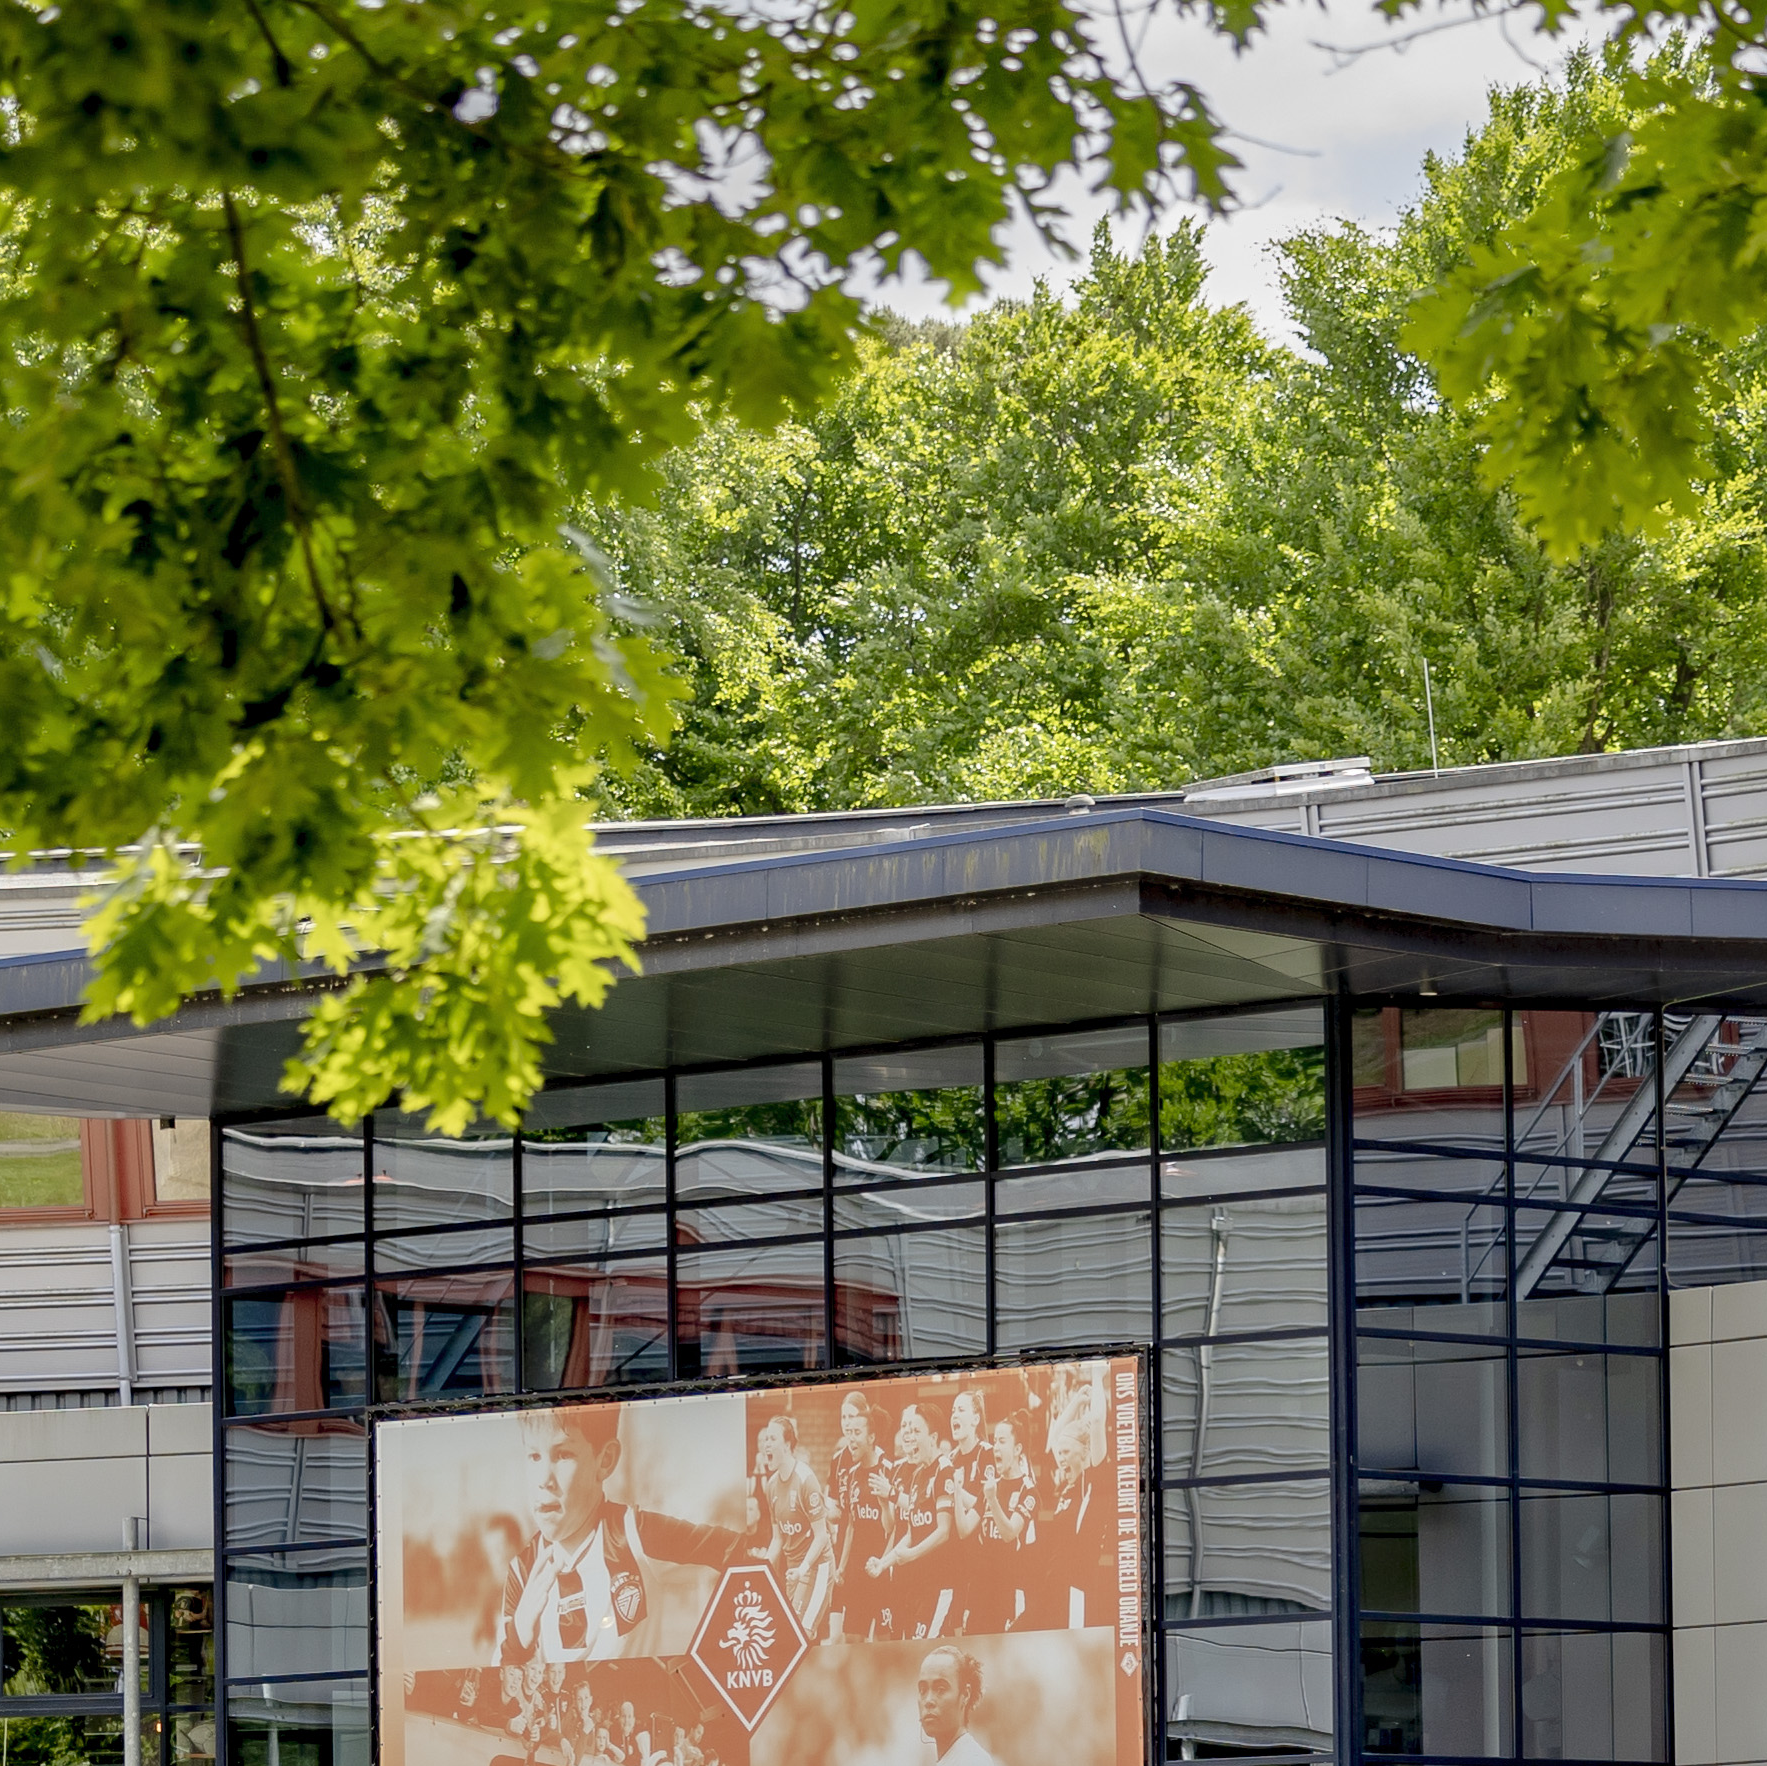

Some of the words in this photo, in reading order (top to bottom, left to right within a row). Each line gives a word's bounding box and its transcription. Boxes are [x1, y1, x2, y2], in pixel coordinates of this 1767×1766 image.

[1116, 1372, 1135, 1400] ONS
[1116, 1401, 1136, 1461] VOETBAL
[1117, 1464, 1137, 1514] KLEURT
[856, 1503, 879, 1520] lebo
[910, 1510, 933, 1527] lebo
[779, 1520, 802, 1536] lebo
[1118, 1518, 1137, 1536] DE
[1118, 1538, 1138, 1593] WERELD
[1119, 1596, 1139, 1648] ORANJE
[727, 1668, 773, 1689] KNVB
